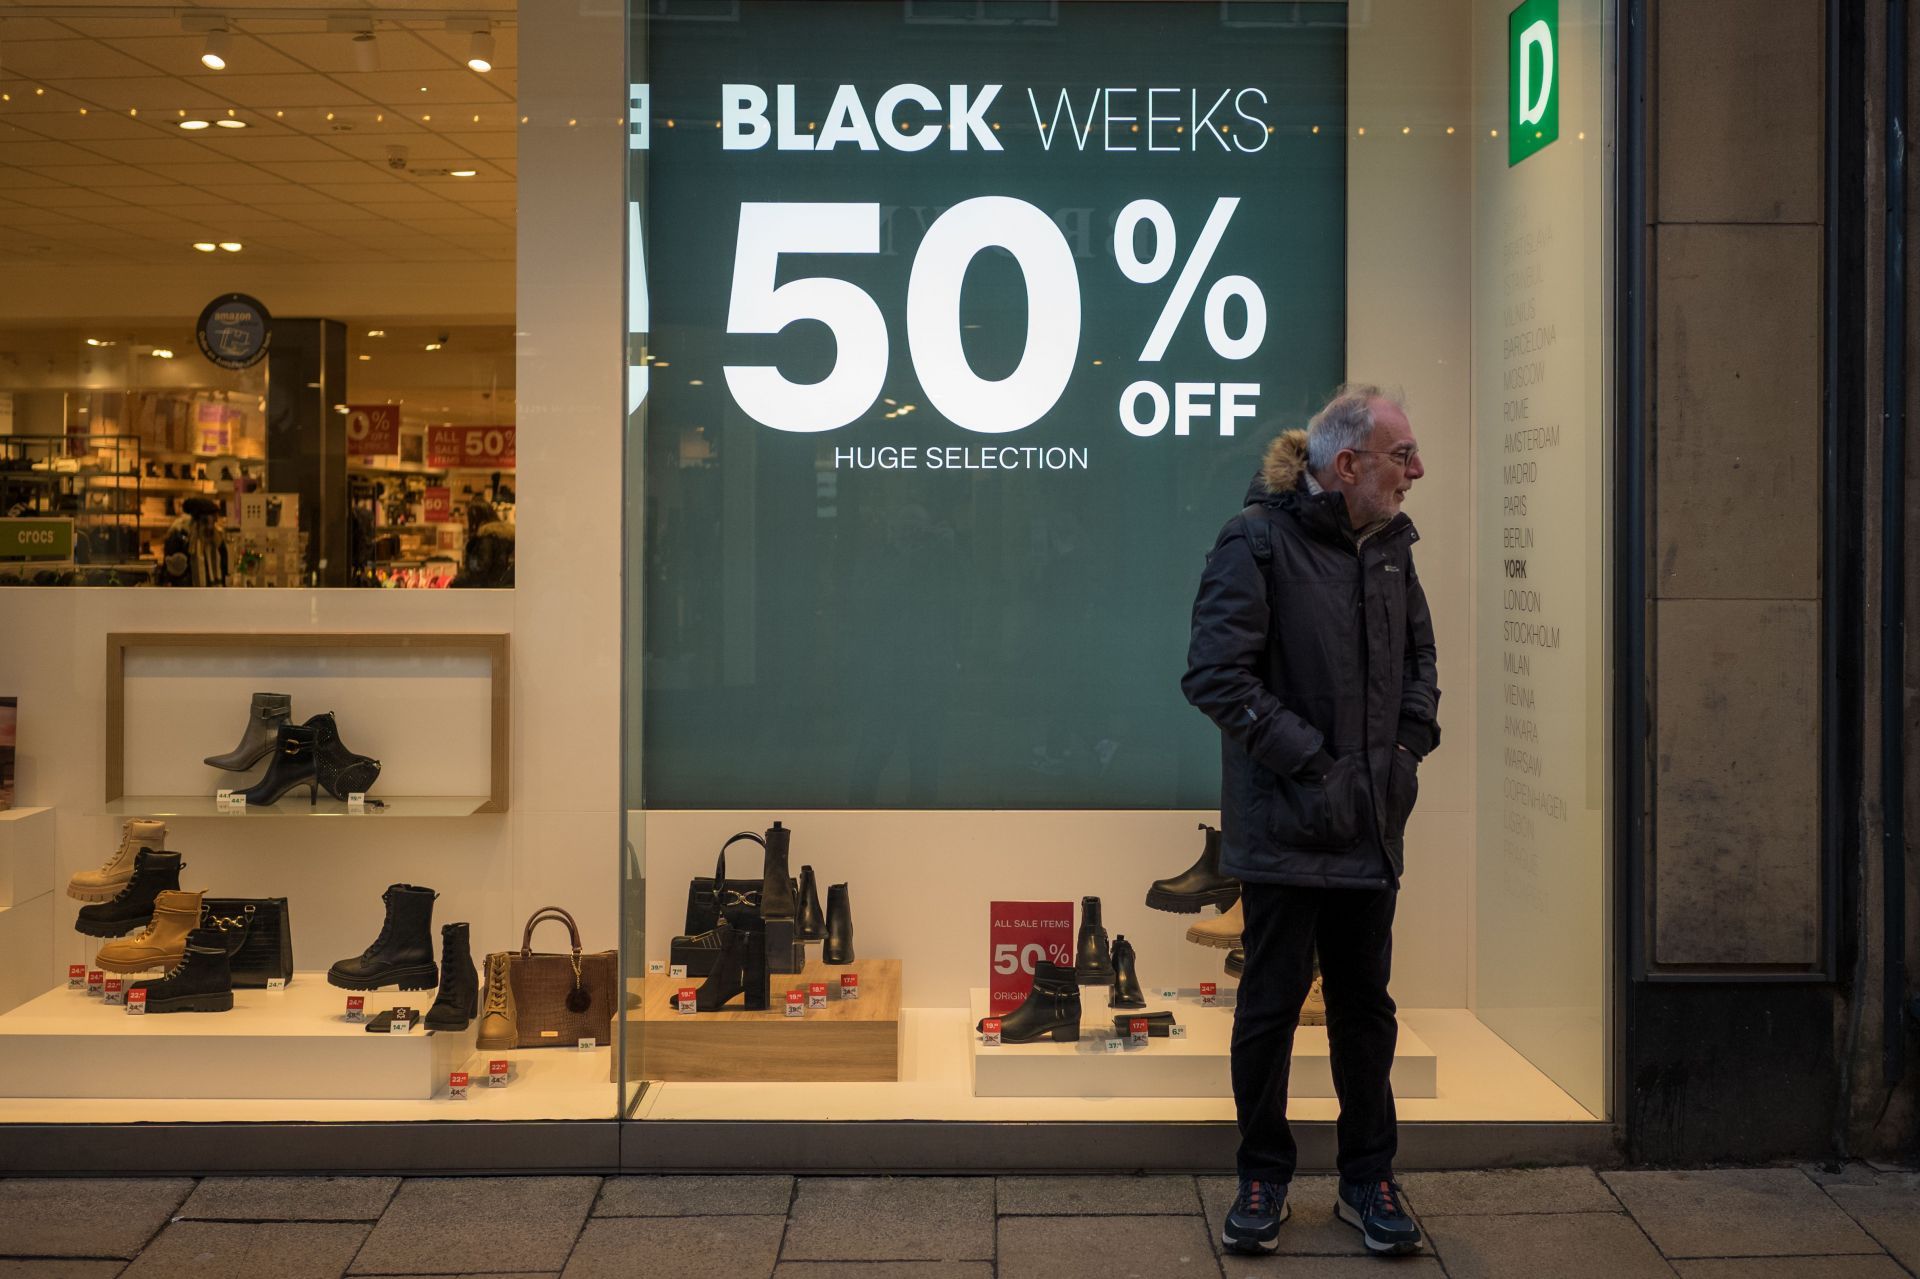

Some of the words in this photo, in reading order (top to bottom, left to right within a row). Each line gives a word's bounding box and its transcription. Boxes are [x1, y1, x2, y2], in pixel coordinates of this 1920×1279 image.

[1519, 19, 1554, 126] D
[721, 84, 1004, 152] BLACK
[1027, 87, 1270, 154] WEEKS
[213, 311, 253, 321] amazon
[722, 195, 1268, 434] 50%
[1503, 324, 1557, 360] BARCELONA
[1503, 360, 1546, 392] MOSCOW
[1118, 381, 1262, 437] OFF
[1503, 397, 1530, 424] ROME
[434, 431, 460, 443] ALL
[434, 444, 460, 455] SALE
[1503, 424, 1561, 454] AMSTERDAM
[834, 446, 917, 470] HUGE
[925, 446, 1090, 470] SELECTION
[1503, 461, 1538, 486] MADRID
[1503, 495, 1528, 517] PARIS
[17, 530, 55, 544] crocs
[1503, 527, 1534, 549] BERLIN
[1503, 559, 1527, 579] YORK
[1503, 589, 1541, 614] LONDON
[1503, 620, 1561, 650] STOCKHOLM
[1503, 651, 1530, 677] MILAN
[1503, 683, 1536, 711] VIENNA
[1503, 715, 1539, 745] ANKARA
[1503, 748, 1543, 778] WARSAW
[1503, 776, 1568, 824] COPENHAGEN
[994, 919, 1012, 928] ALL
[1014, 919, 1038, 928] SALE
[1040, 920, 1070, 928] ITEMS
[994, 943, 1070, 975] 50%
